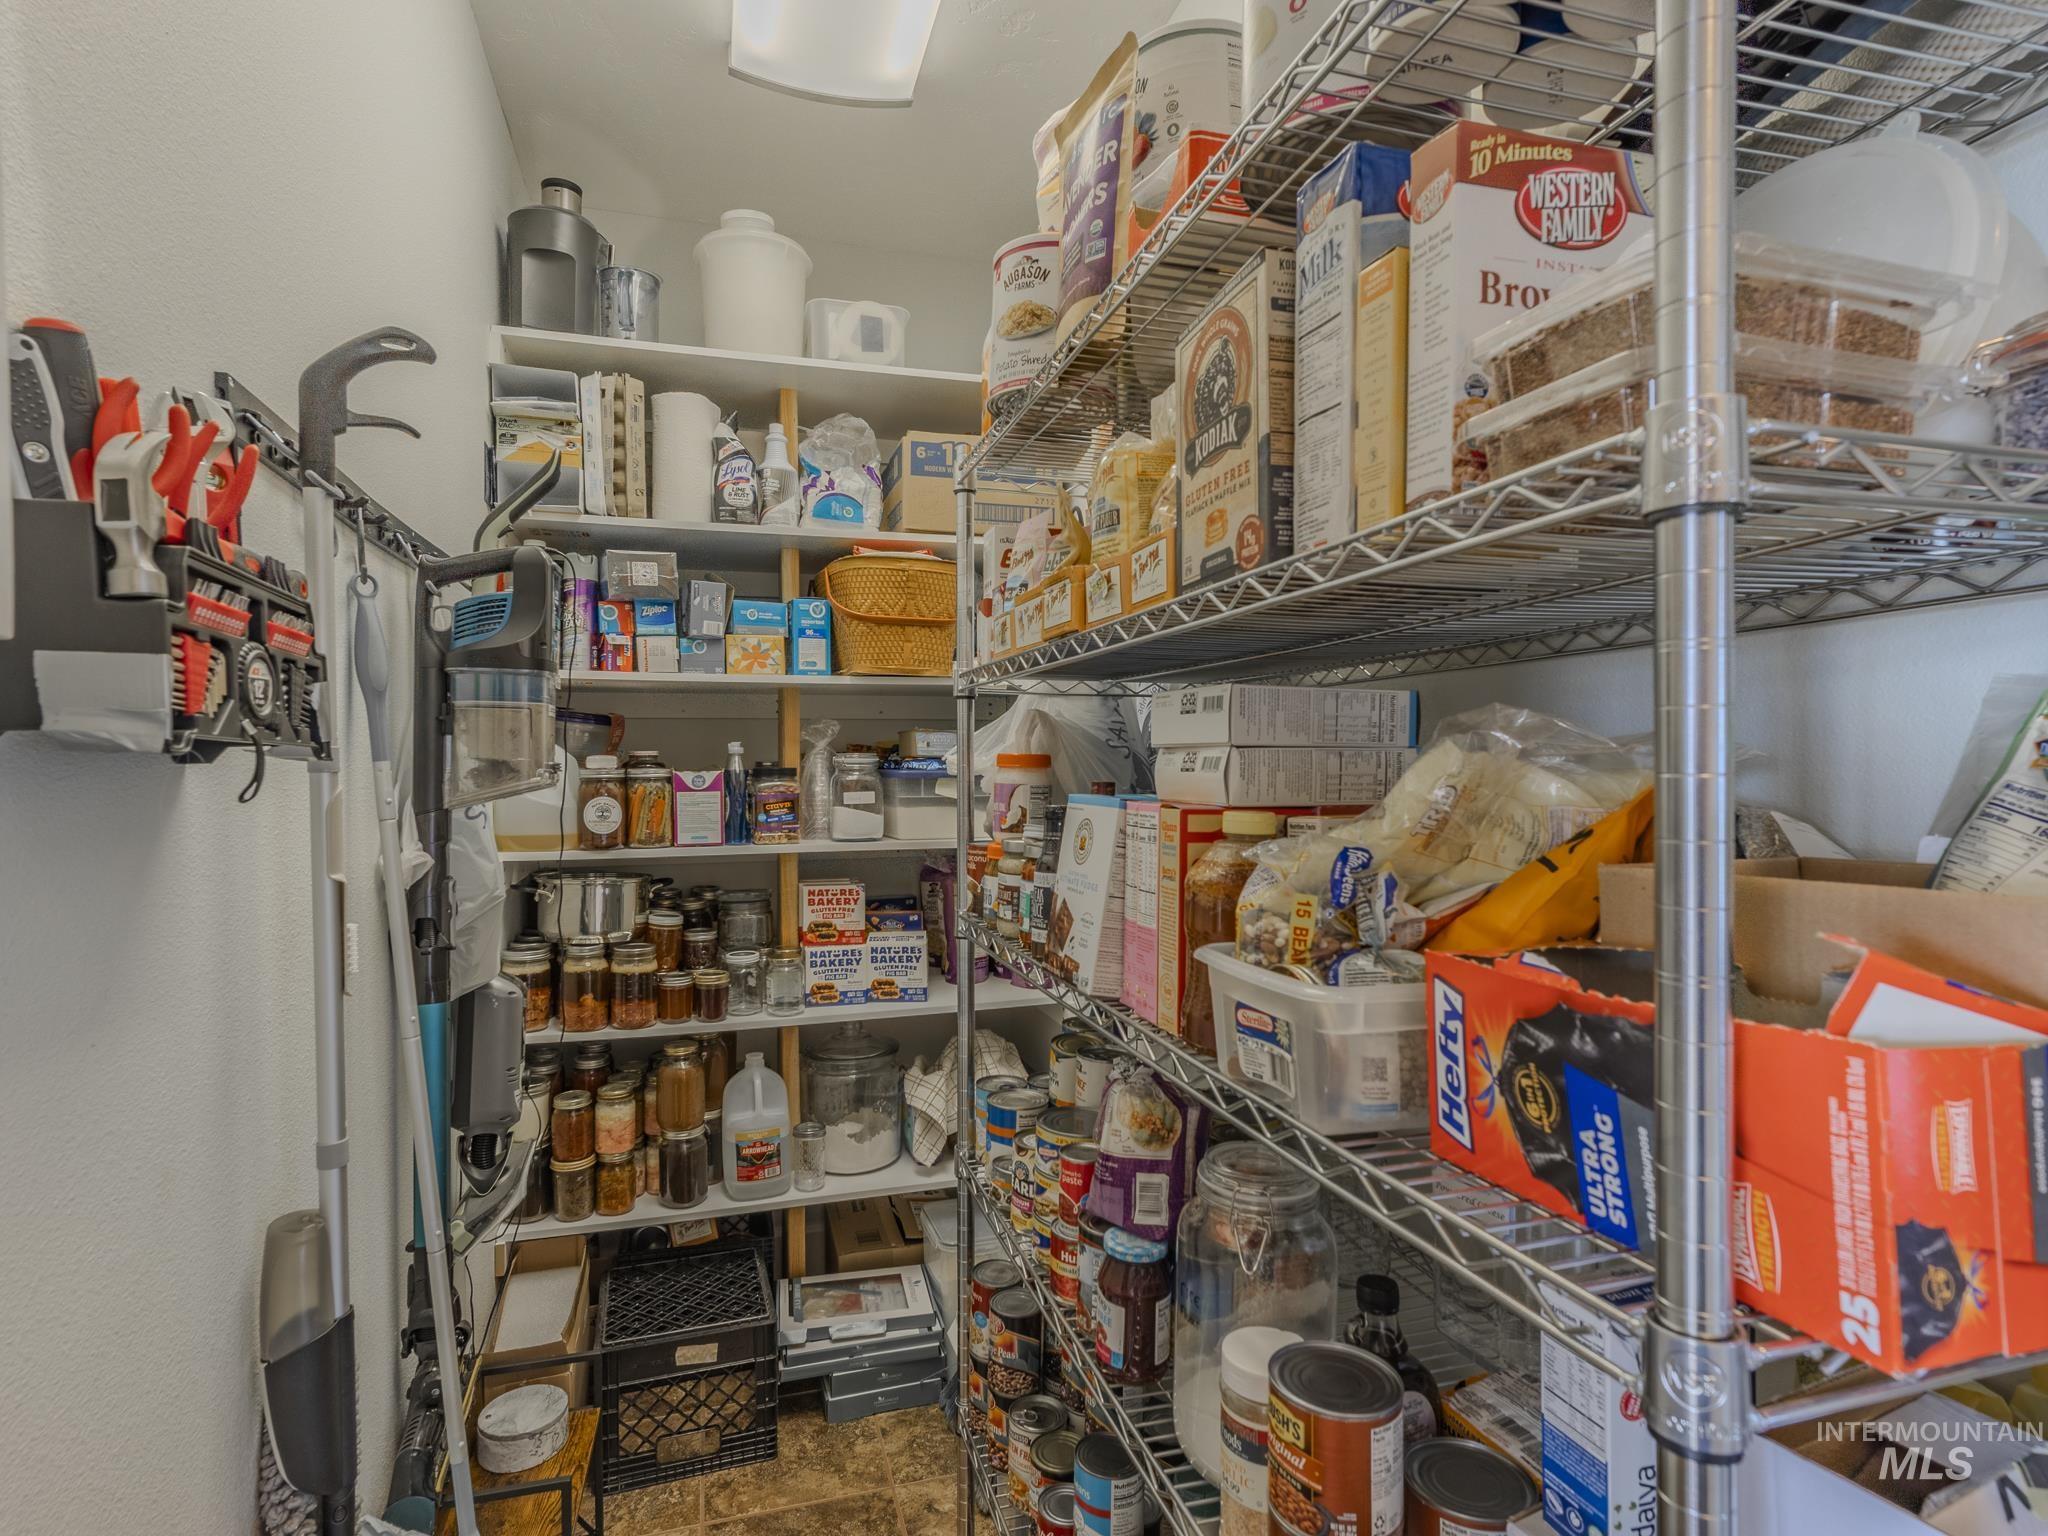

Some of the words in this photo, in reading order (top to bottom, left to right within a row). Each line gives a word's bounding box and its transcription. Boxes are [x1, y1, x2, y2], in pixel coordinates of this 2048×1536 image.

[1470, 135, 1496, 151] Ready
[1470, 151, 1492, 179] 10
[1496, 144, 1573, 166] Minutes
[1528, 172, 1615, 210] WESTERN
[1541, 206, 1605, 245] FAMILY
[1003, 264, 1051, 292] AUGASON
[1299, 237, 1343, 300] Milk
[1014, 279, 1036, 292] FARMS
[1480, 269, 1551, 310] Brow
[916, 446, 926, 459] 6
[1195, 411, 1238, 468] KODIAK
[722, 461, 751, 479] Lysol
[1185, 475, 1220, 507] GLUTEN
[1223, 459, 1250, 482] FREE
[641, 605, 668, 617] Ziploc
[807, 897, 860, 906] BAKERY
[1296, 900, 1313, 919] 15
[809, 957, 862, 968] BAKERY
[813, 968, 839, 976] GLUTEN
[870, 955, 922, 964] BAKERY
[1440, 990, 1465, 1137] Hefty
[1062, 1174, 1083, 1186] paste
[1579, 1128, 1608, 1218] ULTRA
[1594, 1112, 1628, 1228] STRONG
[1840, 1290, 1881, 1356] 25
[1631, 1465, 1657, 1536] daiya
